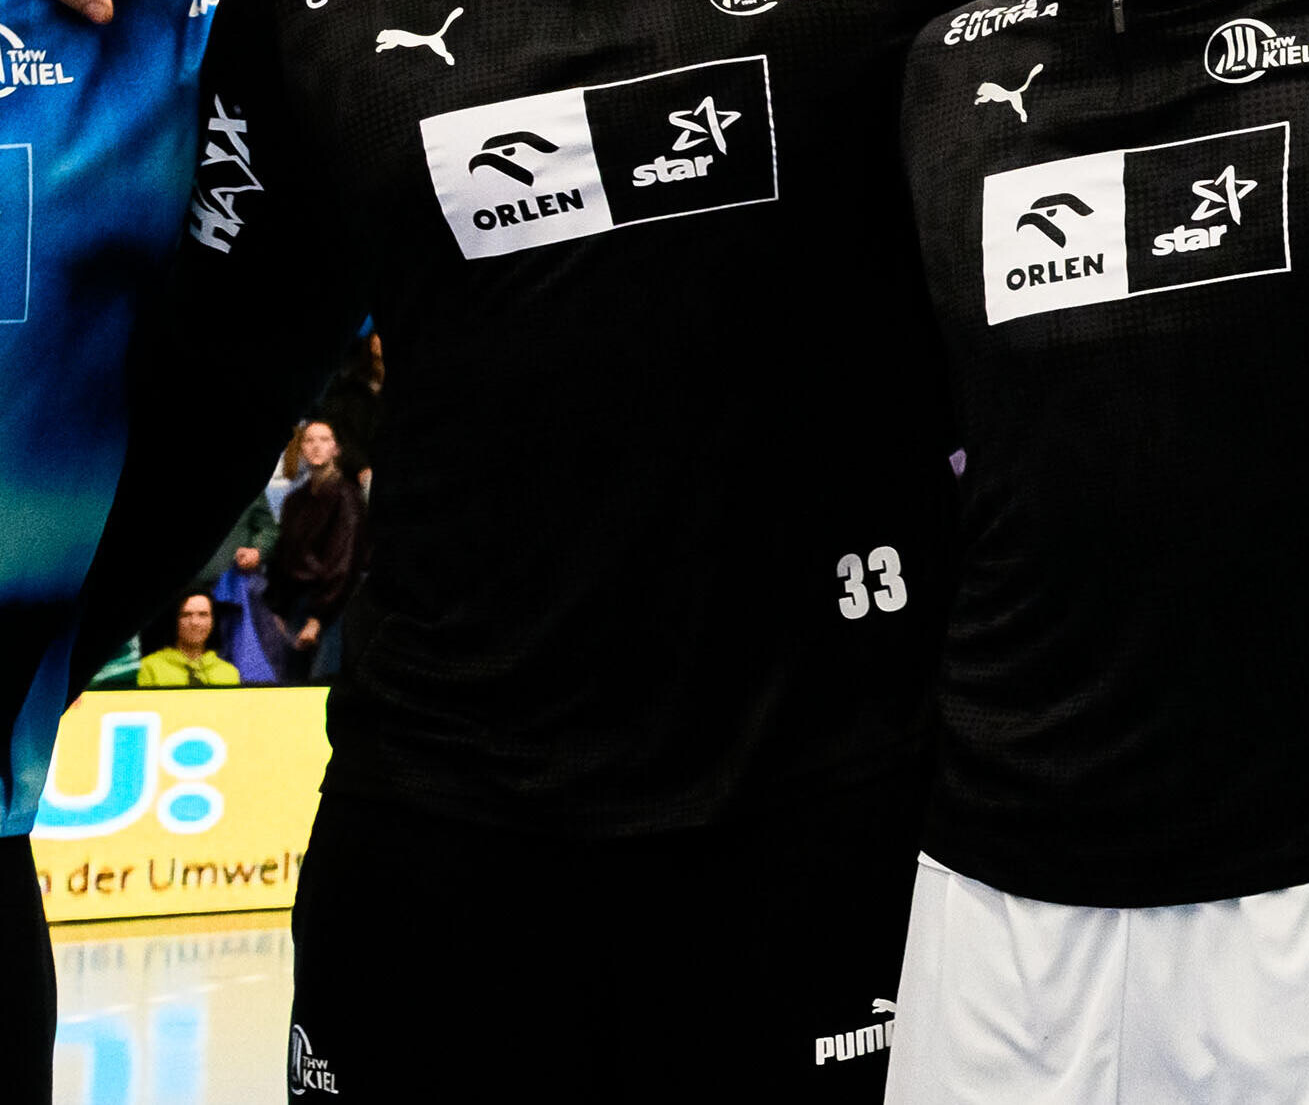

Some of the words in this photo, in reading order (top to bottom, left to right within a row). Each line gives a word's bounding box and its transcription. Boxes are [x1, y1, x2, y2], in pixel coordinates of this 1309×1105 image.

[7, 48, 46, 63] THW
[1261, 36, 1296, 51] THW
[11, 62, 74, 86] KIEL
[632, 153, 714, 186] star
[472, 188, 585, 231] ORLEN
[1152, 224, 1228, 257] star
[1005, 254, 1105, 292] ORLEN
[836, 546, 908, 620] 33
[68, 856, 134, 894] der
[302, 1055, 328, 1070] THW
[303, 1068, 339, 1094] KIEL
